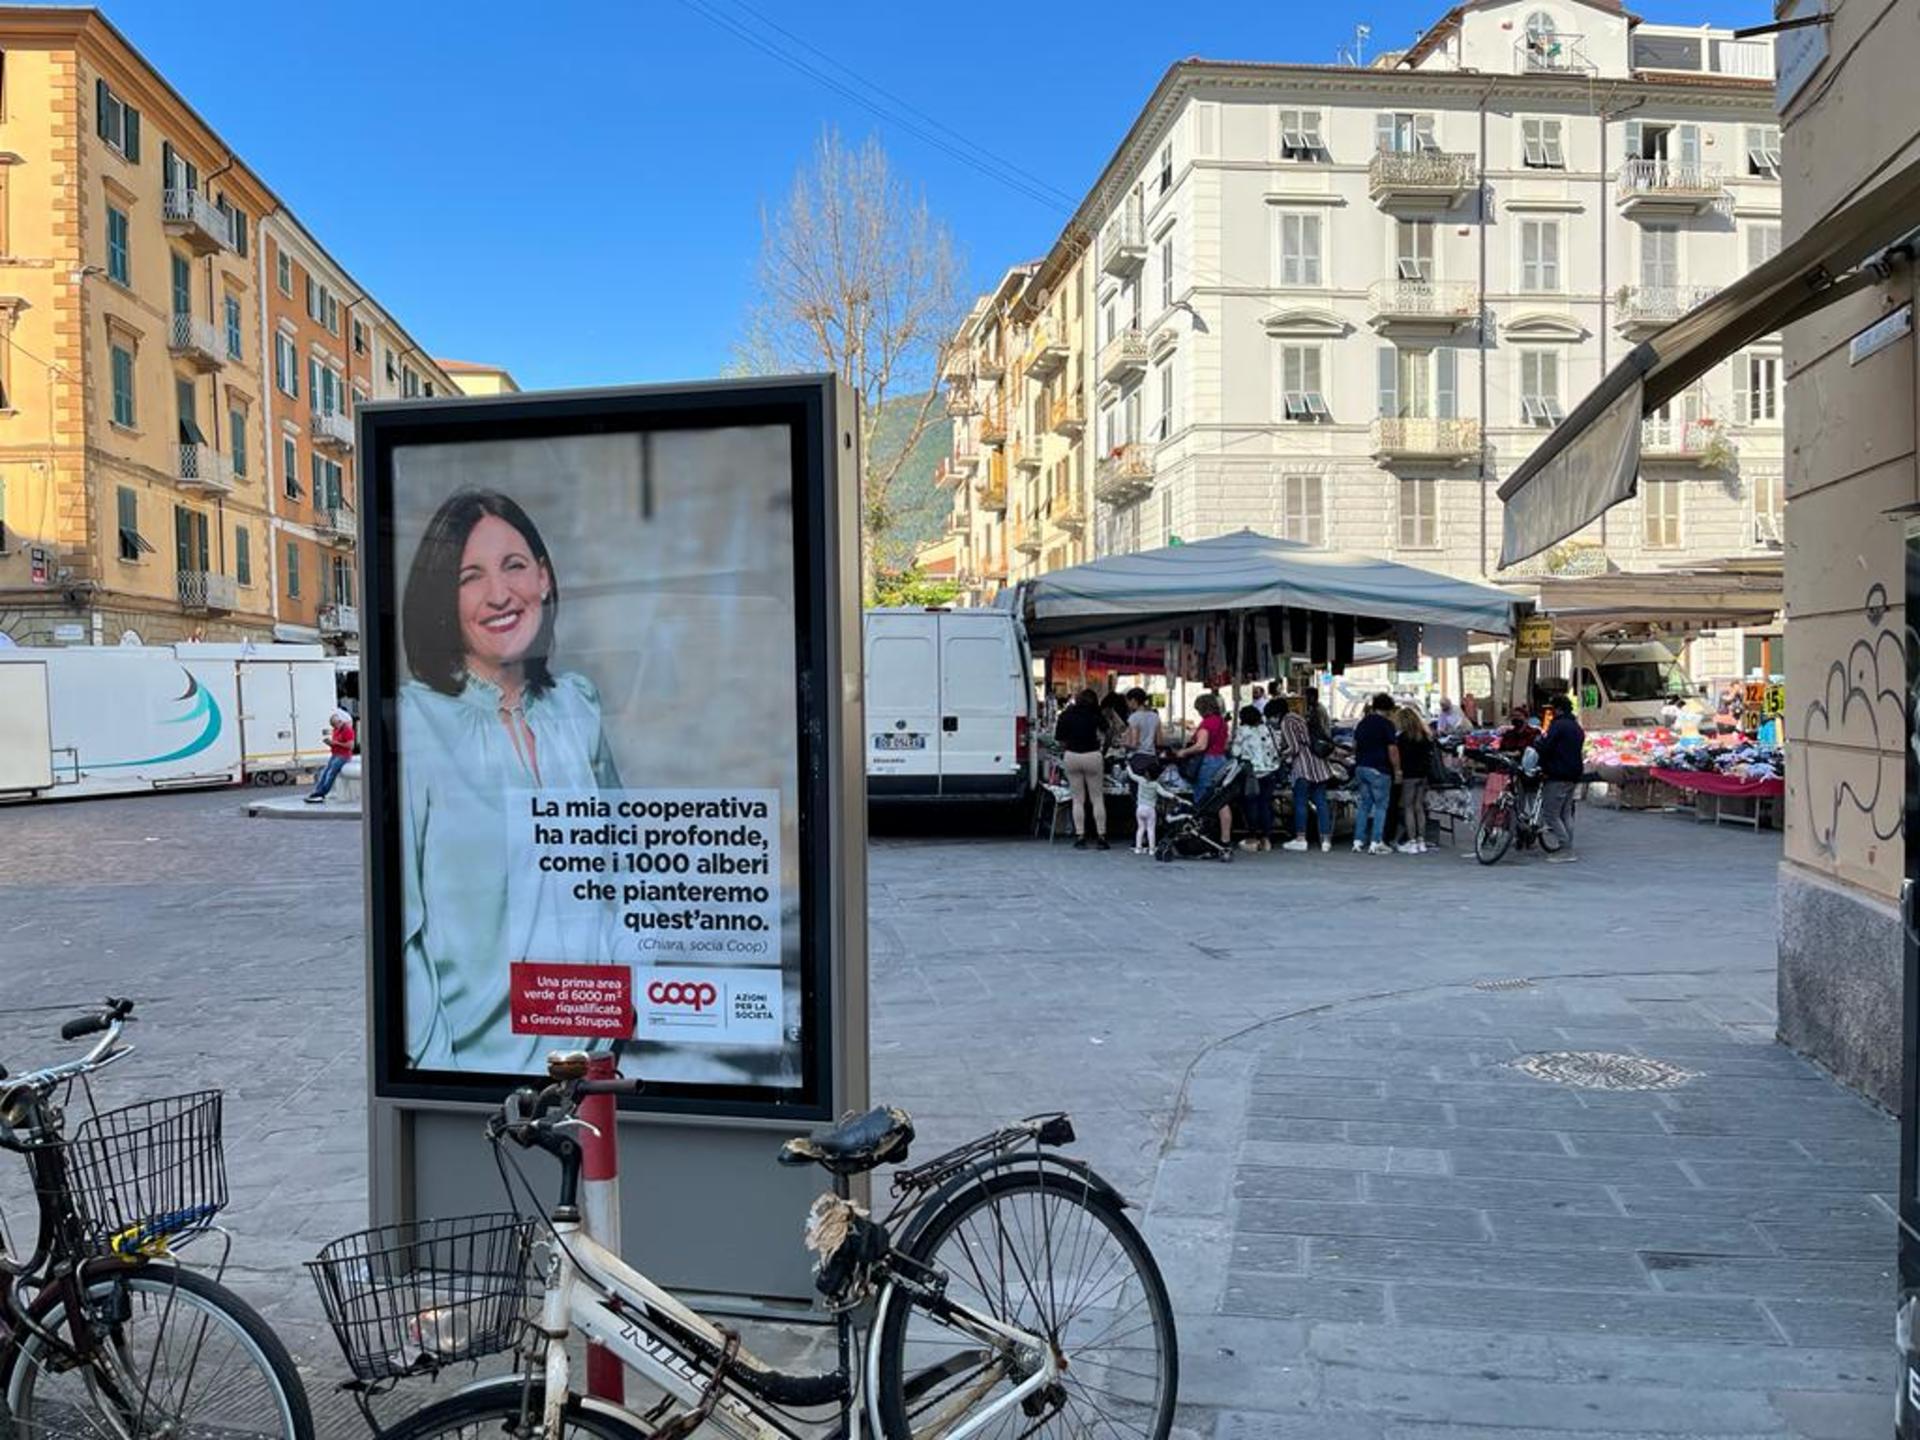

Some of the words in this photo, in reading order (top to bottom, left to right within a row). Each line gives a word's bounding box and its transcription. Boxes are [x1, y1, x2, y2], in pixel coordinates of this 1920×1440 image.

[531, 797, 559, 817] La
[566, 797, 611, 818] mia
[617, 797, 768, 821] cooperativa
[535, 824, 563, 845] ha
[570, 824, 638, 846] radici
[645, 825, 769, 849] profonde,
[539, 856, 605, 873] come
[612, 852, 619, 873] i
[625, 853, 690, 874] 1000
[696, 854, 768, 875] alberi
[573, 880, 616, 901] che
[623, 880, 769, 904] pianteremo
[624, 910, 769, 933] quest'anno.
[638, 938, 685, 952] (Chiara,
[690, 940, 723, 952] socia
[727, 940, 769, 953] Coop)
[537, 976, 560, 988] Una
[561, 977, 595, 989] prima
[596, 979, 622, 989] area
[523, 989, 556, 1000] verde
[558, 990, 569, 1000] di
[571, 990, 602, 1002] 6000
[647, 981, 717, 1012] coop
[734, 993, 768, 1002] AZIONI
[555, 1002, 623, 1015] riqualificata
[734, 1002, 753, 1010] PER
[755, 1002, 766, 1010] LA
[520, 1015, 528, 1025] a
[529, 1013, 573, 1026] Genova
[574, 1015, 623, 1029] Struppa.
